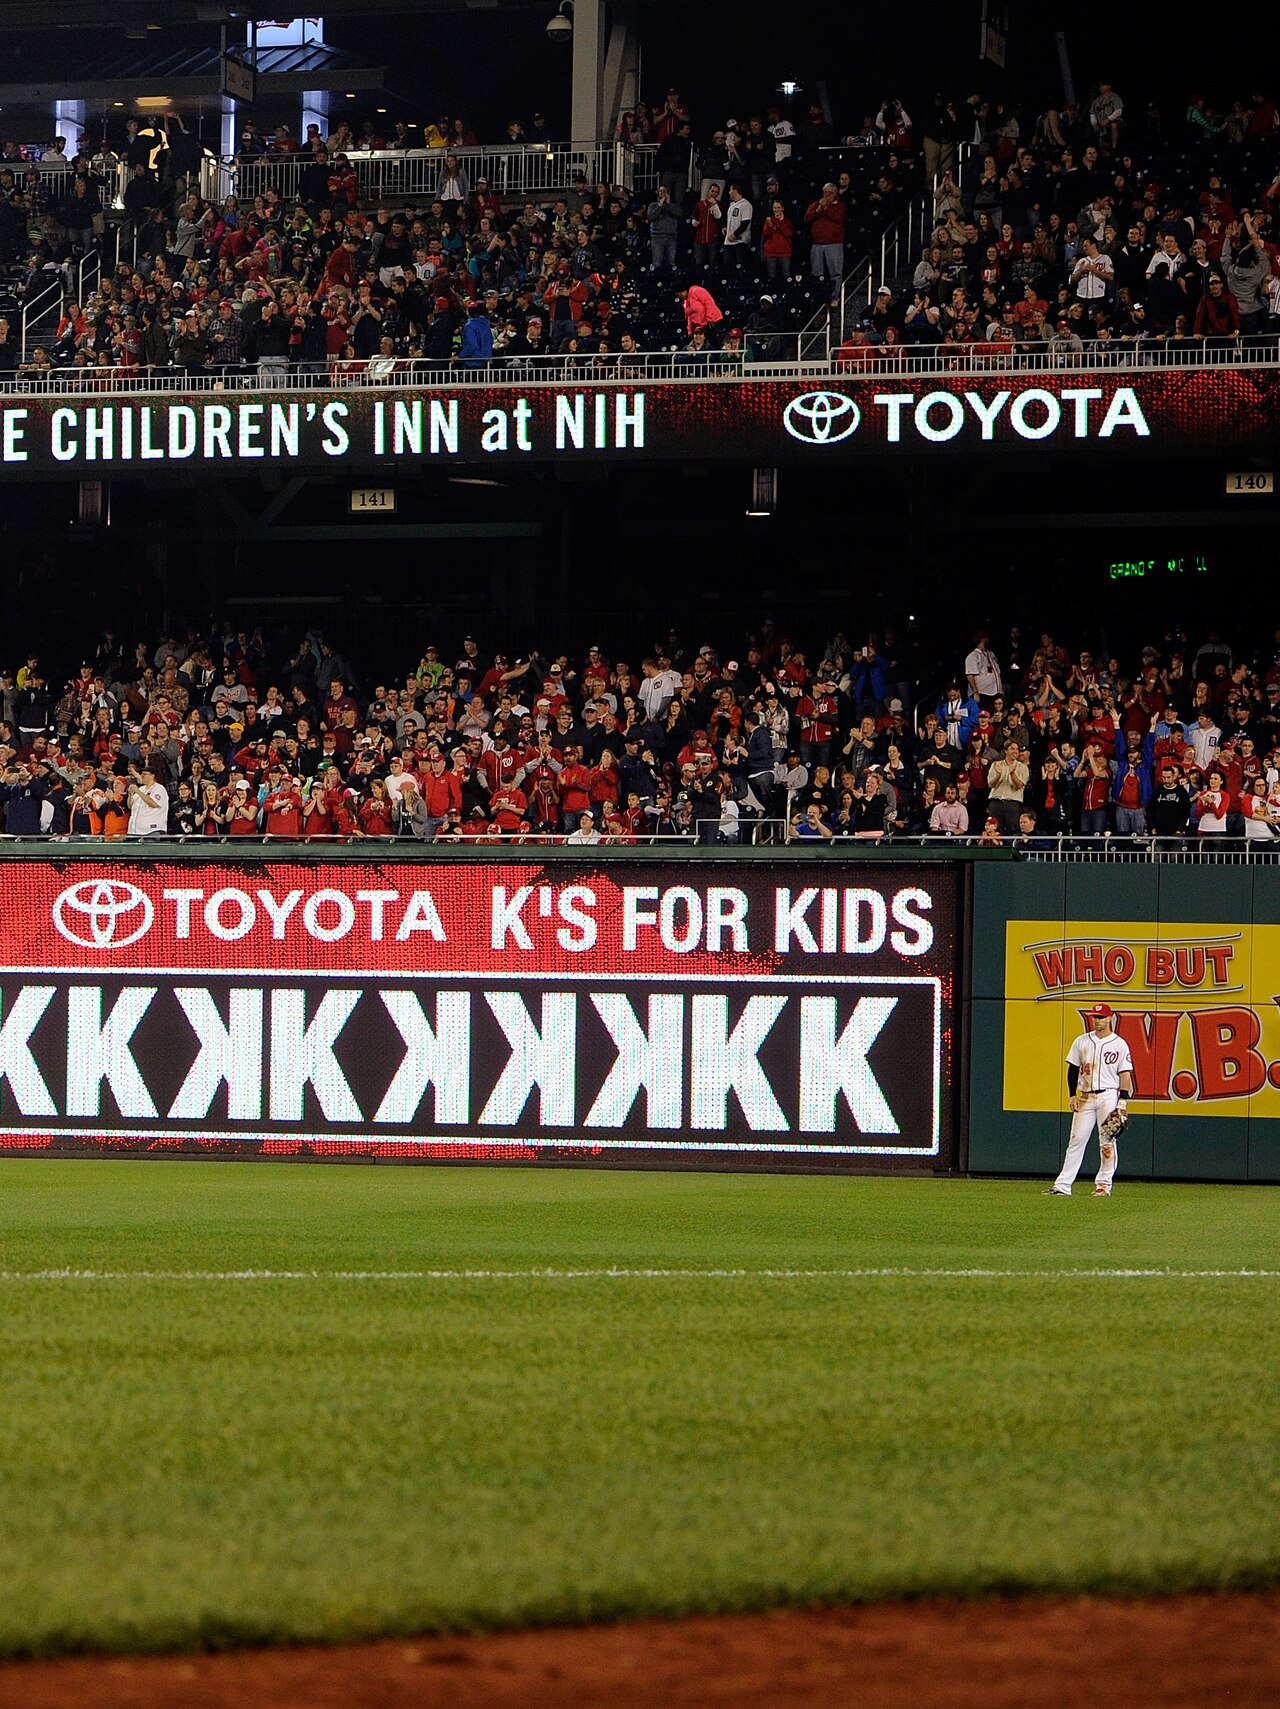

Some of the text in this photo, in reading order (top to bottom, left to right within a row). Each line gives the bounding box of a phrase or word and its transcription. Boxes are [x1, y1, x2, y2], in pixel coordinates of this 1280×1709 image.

[52, 401, 349, 461] CHILDREN'S
[375, 399, 458, 455] INN
[482, 405, 532, 452] at
[556, 394, 644, 449] NIH
[874, 388, 1150, 442] TOYOTA
[359, 491, 388, 507] 141
[1234, 474, 1267, 490] 140
[1109, 560, 1146, 579] GRAND
[164, 880, 934, 959] TOYOTA K'S FOR KIDS
[1033, 945, 1234, 990] WHO BUT
